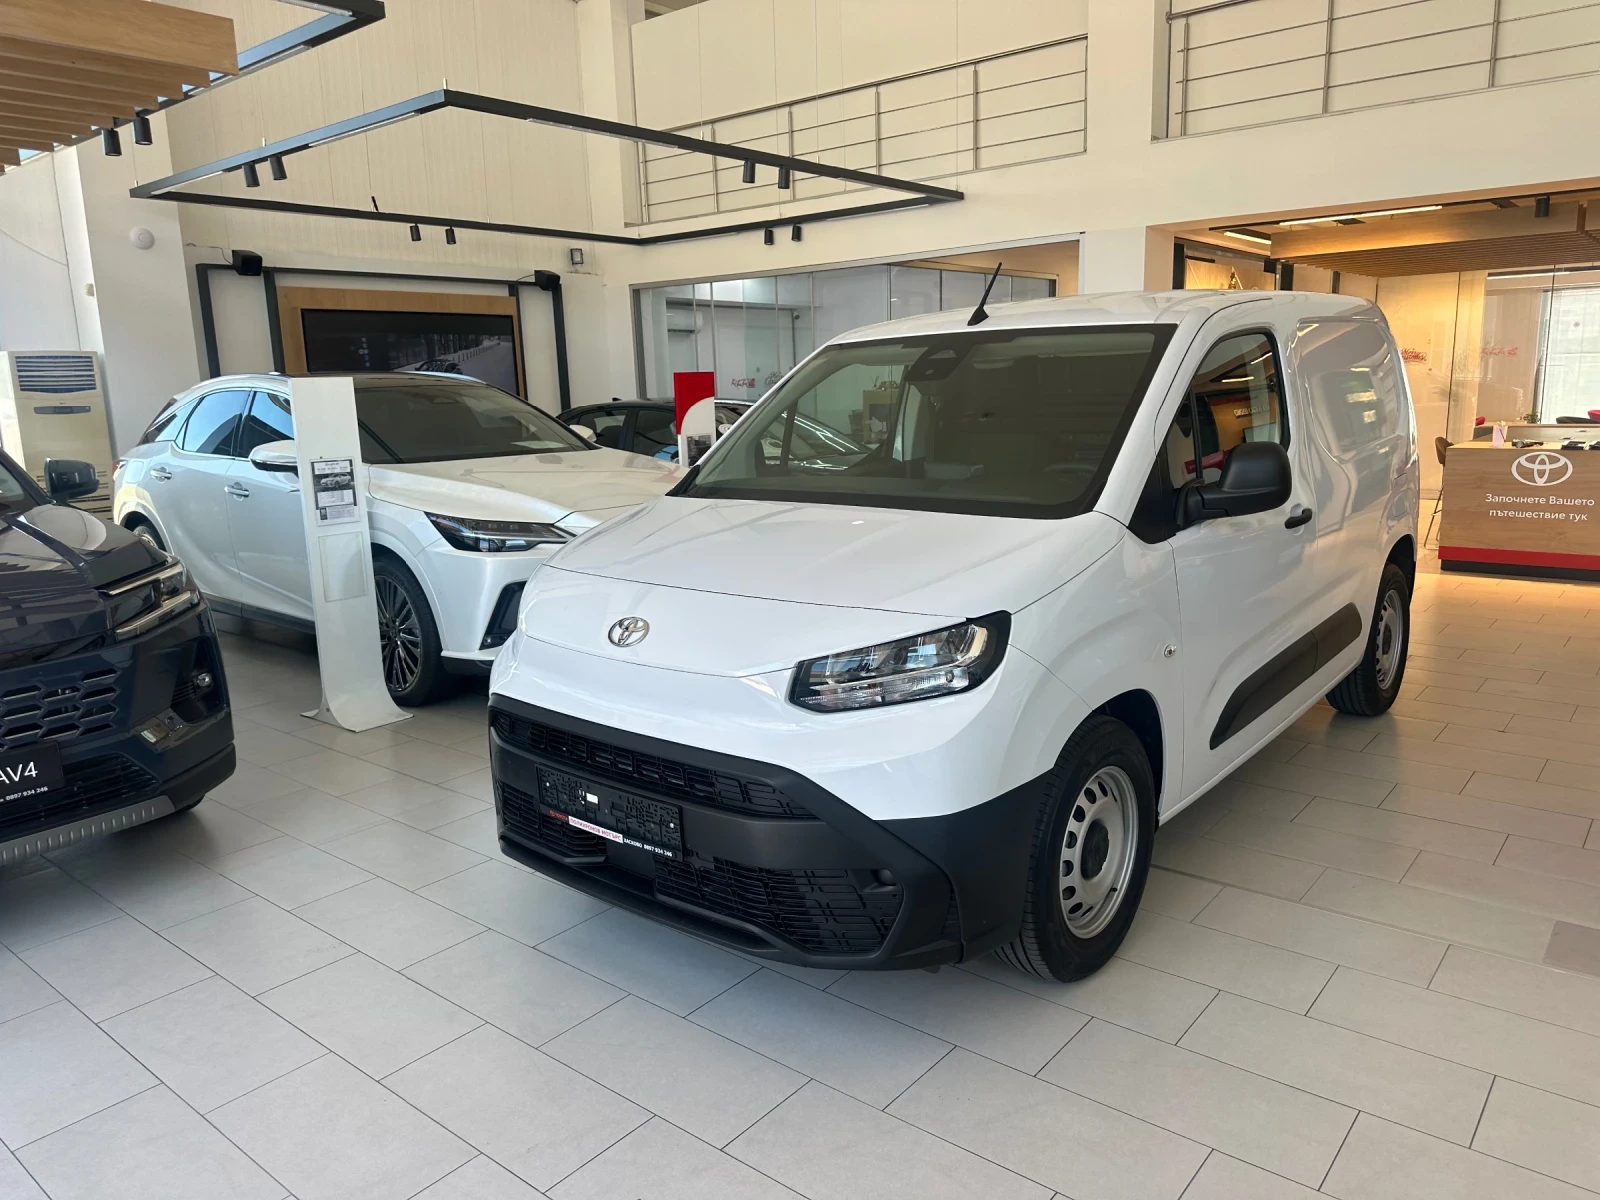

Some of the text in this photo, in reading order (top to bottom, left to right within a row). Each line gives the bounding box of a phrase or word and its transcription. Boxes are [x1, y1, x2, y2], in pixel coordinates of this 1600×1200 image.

[1485, 493, 1595, 506] Започнете Вашето
[1489, 510, 1588, 522] пътешествие тук
[22, 789, 35, 797] 934
[36, 786, 48, 794] 246
